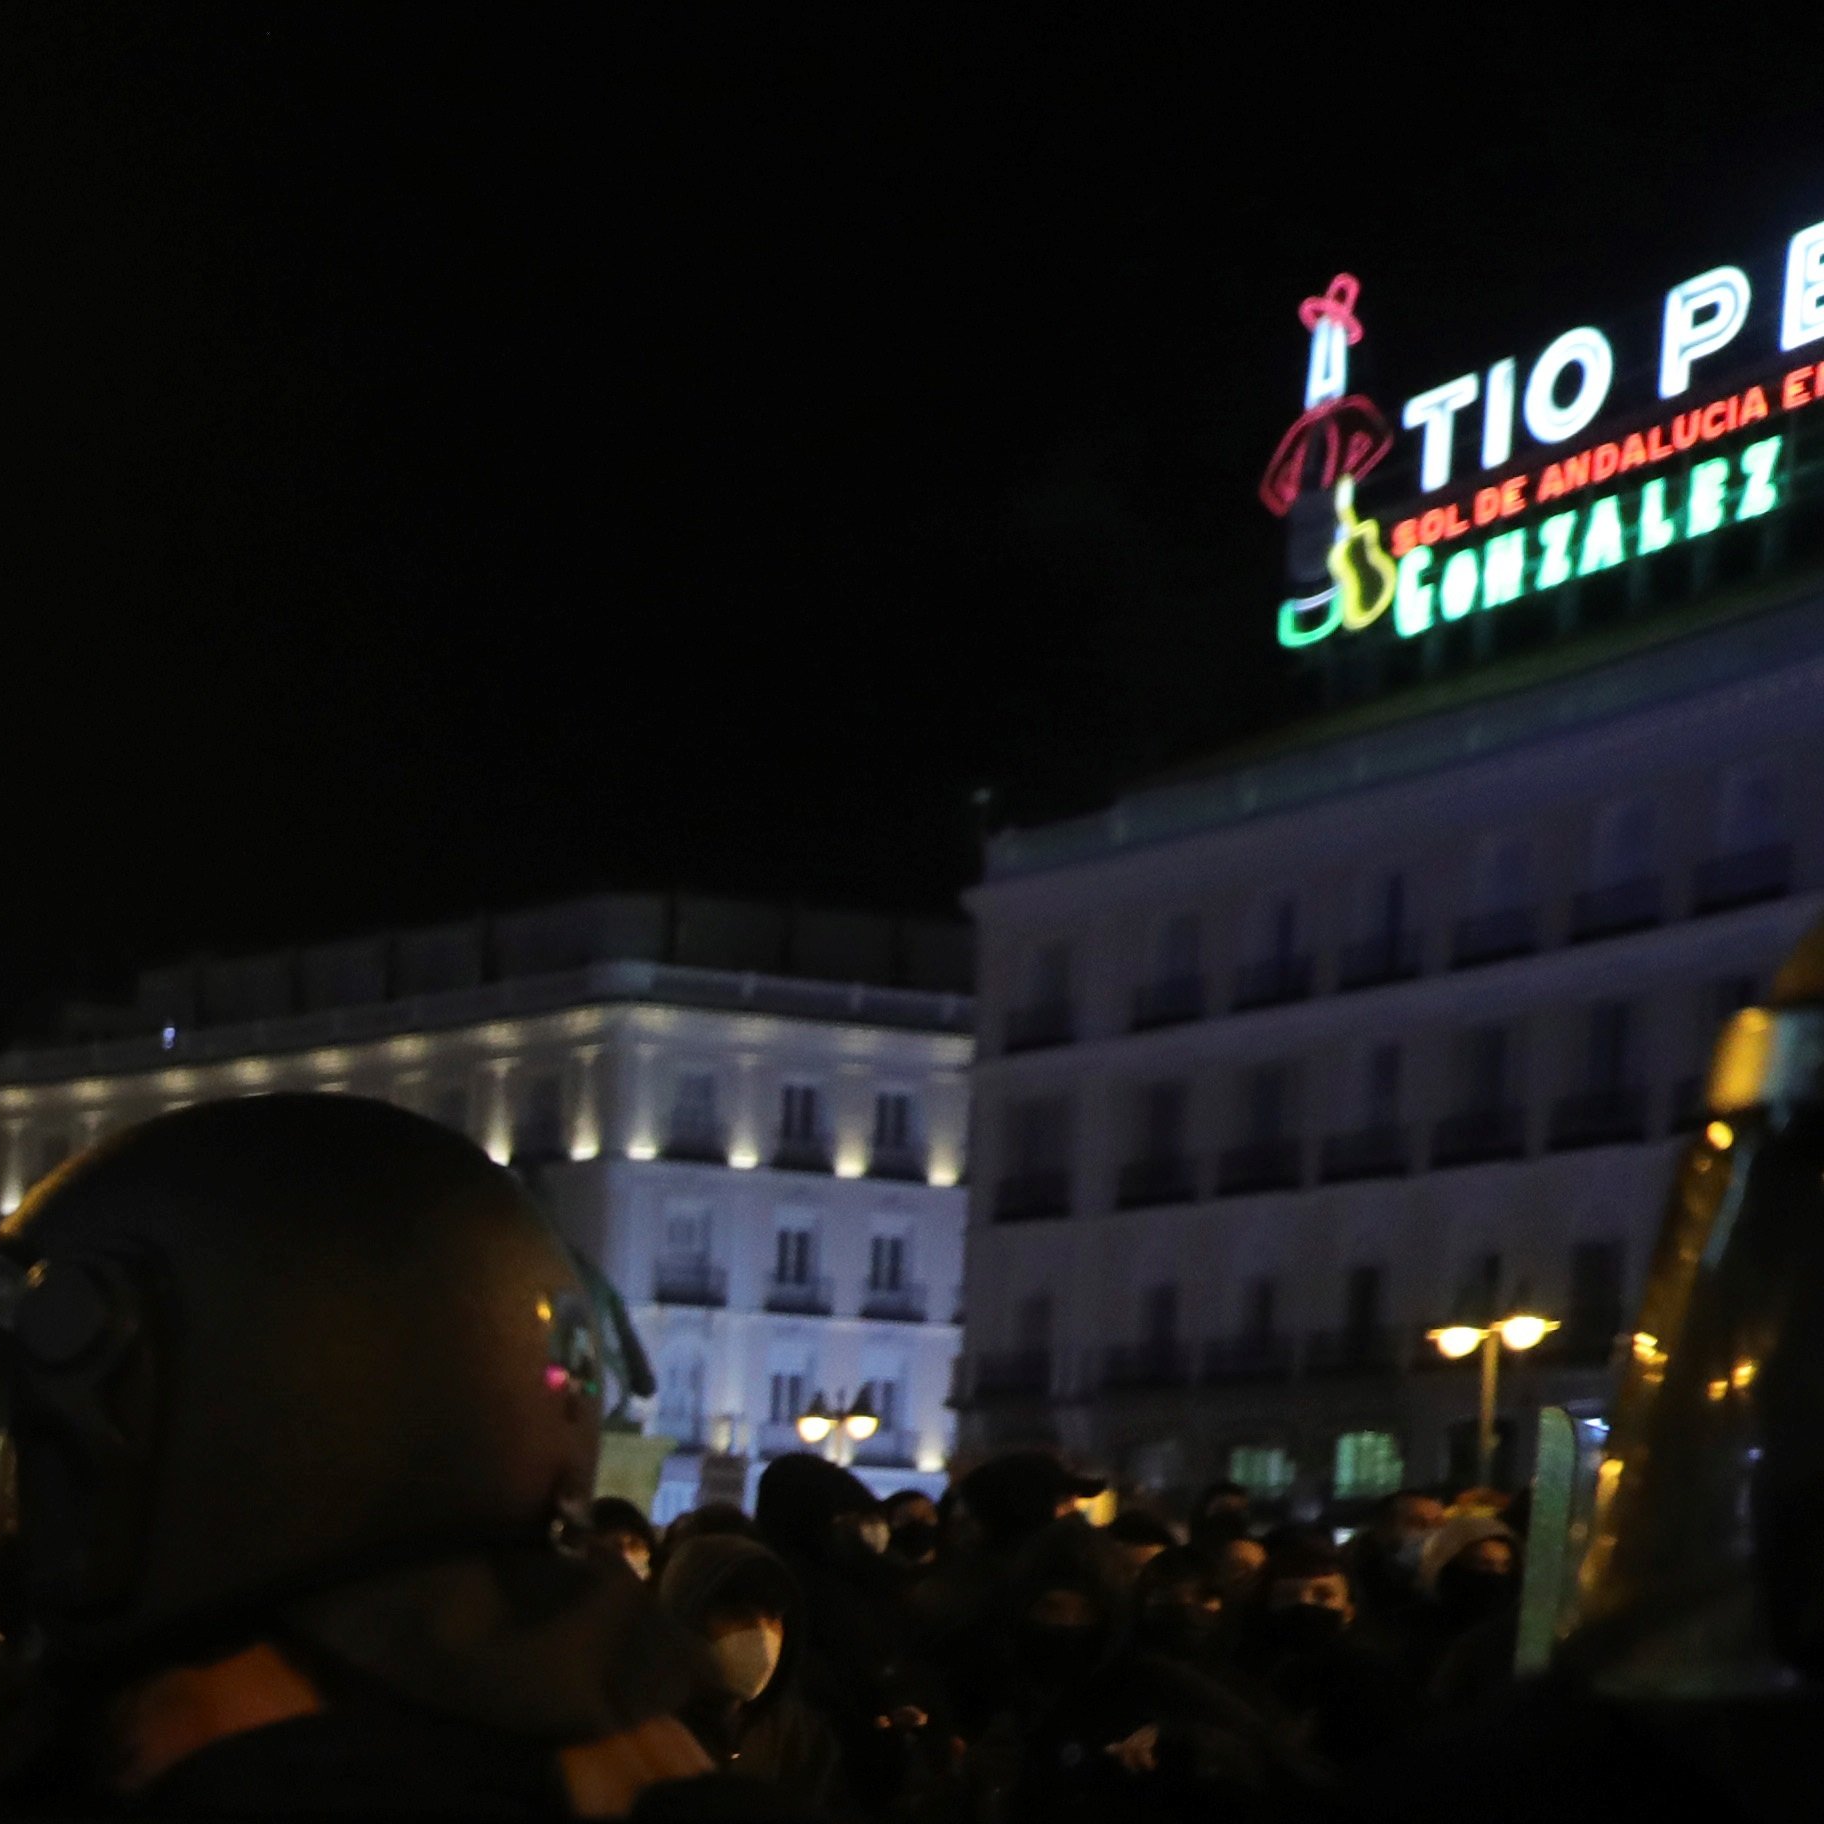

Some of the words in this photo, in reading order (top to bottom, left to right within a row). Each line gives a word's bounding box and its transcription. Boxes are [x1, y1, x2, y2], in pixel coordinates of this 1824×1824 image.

[1391, 503, 1471, 558] SOL
[1472, 473, 1528, 525] DE
[1536, 383, 1770, 503] ANDALUCIA
[1401, 326, 1614, 494] TIO
[1393, 434, 1784, 639] GONZALEZ
